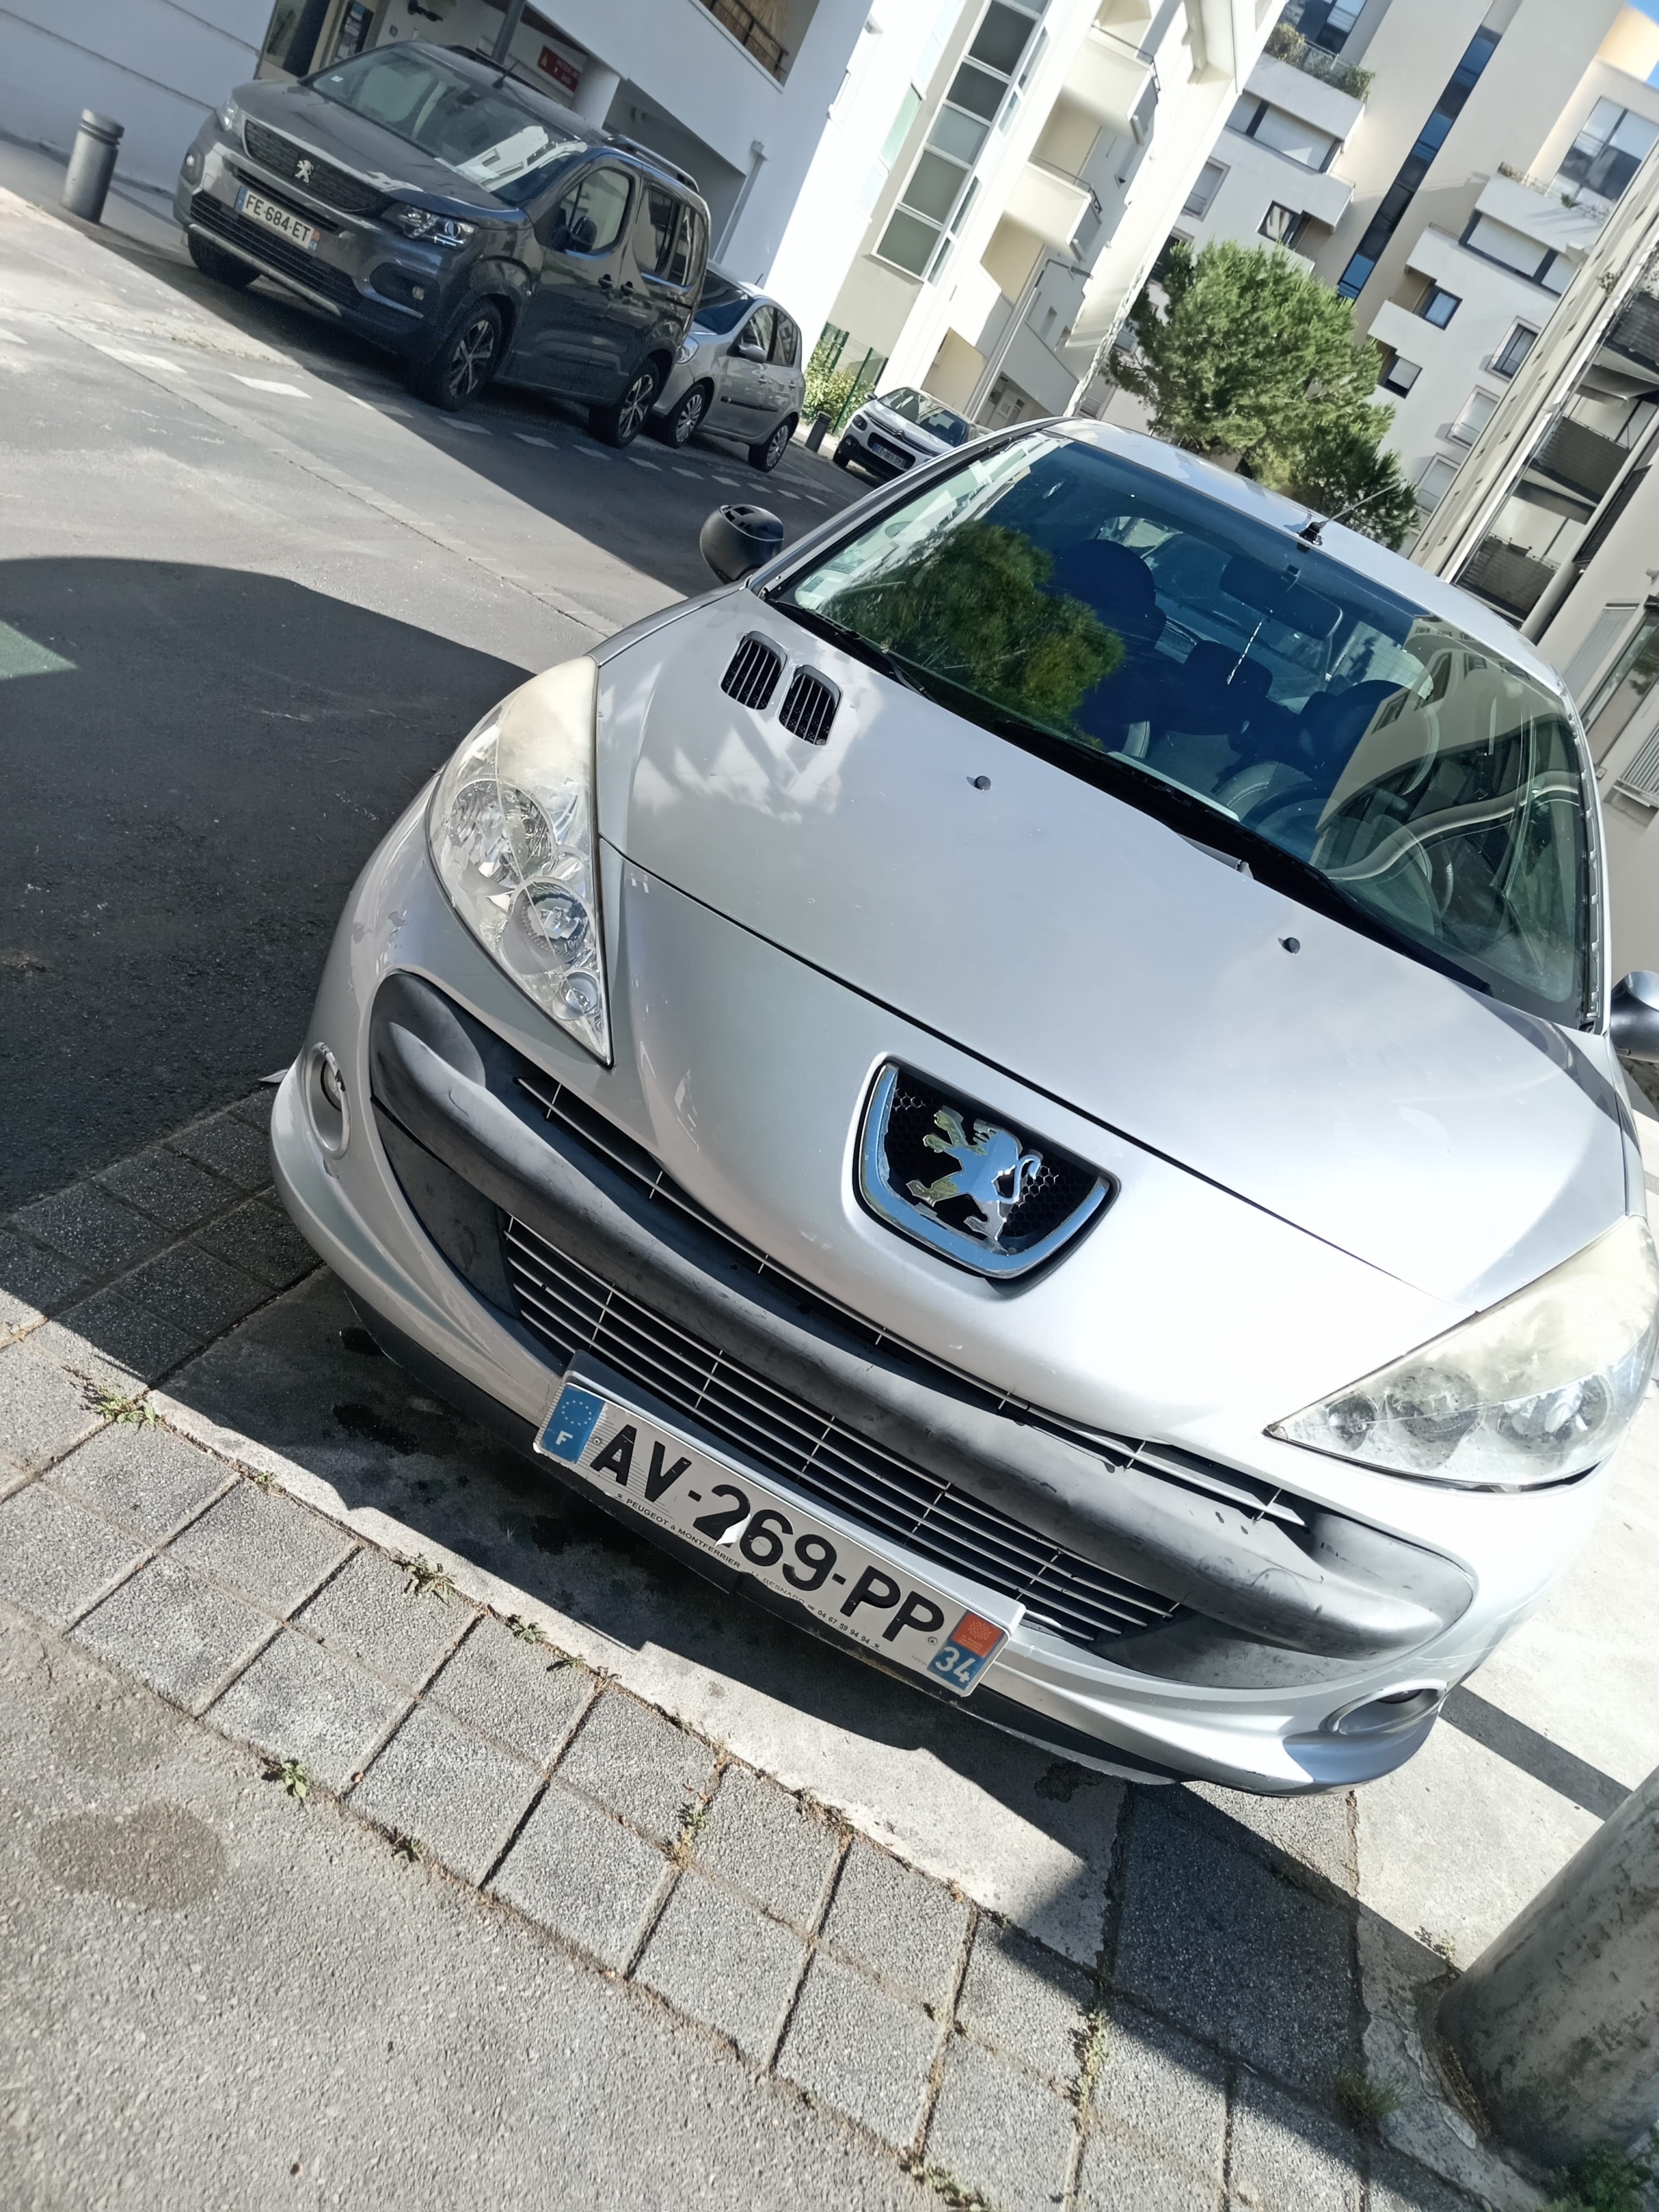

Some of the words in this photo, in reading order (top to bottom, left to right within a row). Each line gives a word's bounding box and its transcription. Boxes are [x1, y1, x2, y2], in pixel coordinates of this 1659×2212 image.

[246, 194, 311, 242] FE-684-ET
[555, 1431, 573, 1446] F
[590, 1424, 945, 1642] AV-269-PP
[626, 1498, 669, 1526] PEUGEOT
[678, 1528, 740, 1568] MONTFERRIER
[817, 1609, 826, 1618] 04
[828, 1616, 838, 1624] 67
[839, 1623, 848, 1631] 59
[849, 1629, 859, 1637] 94
[861, 1636, 870, 1644] 94
[935, 1647, 975, 1683] 34
